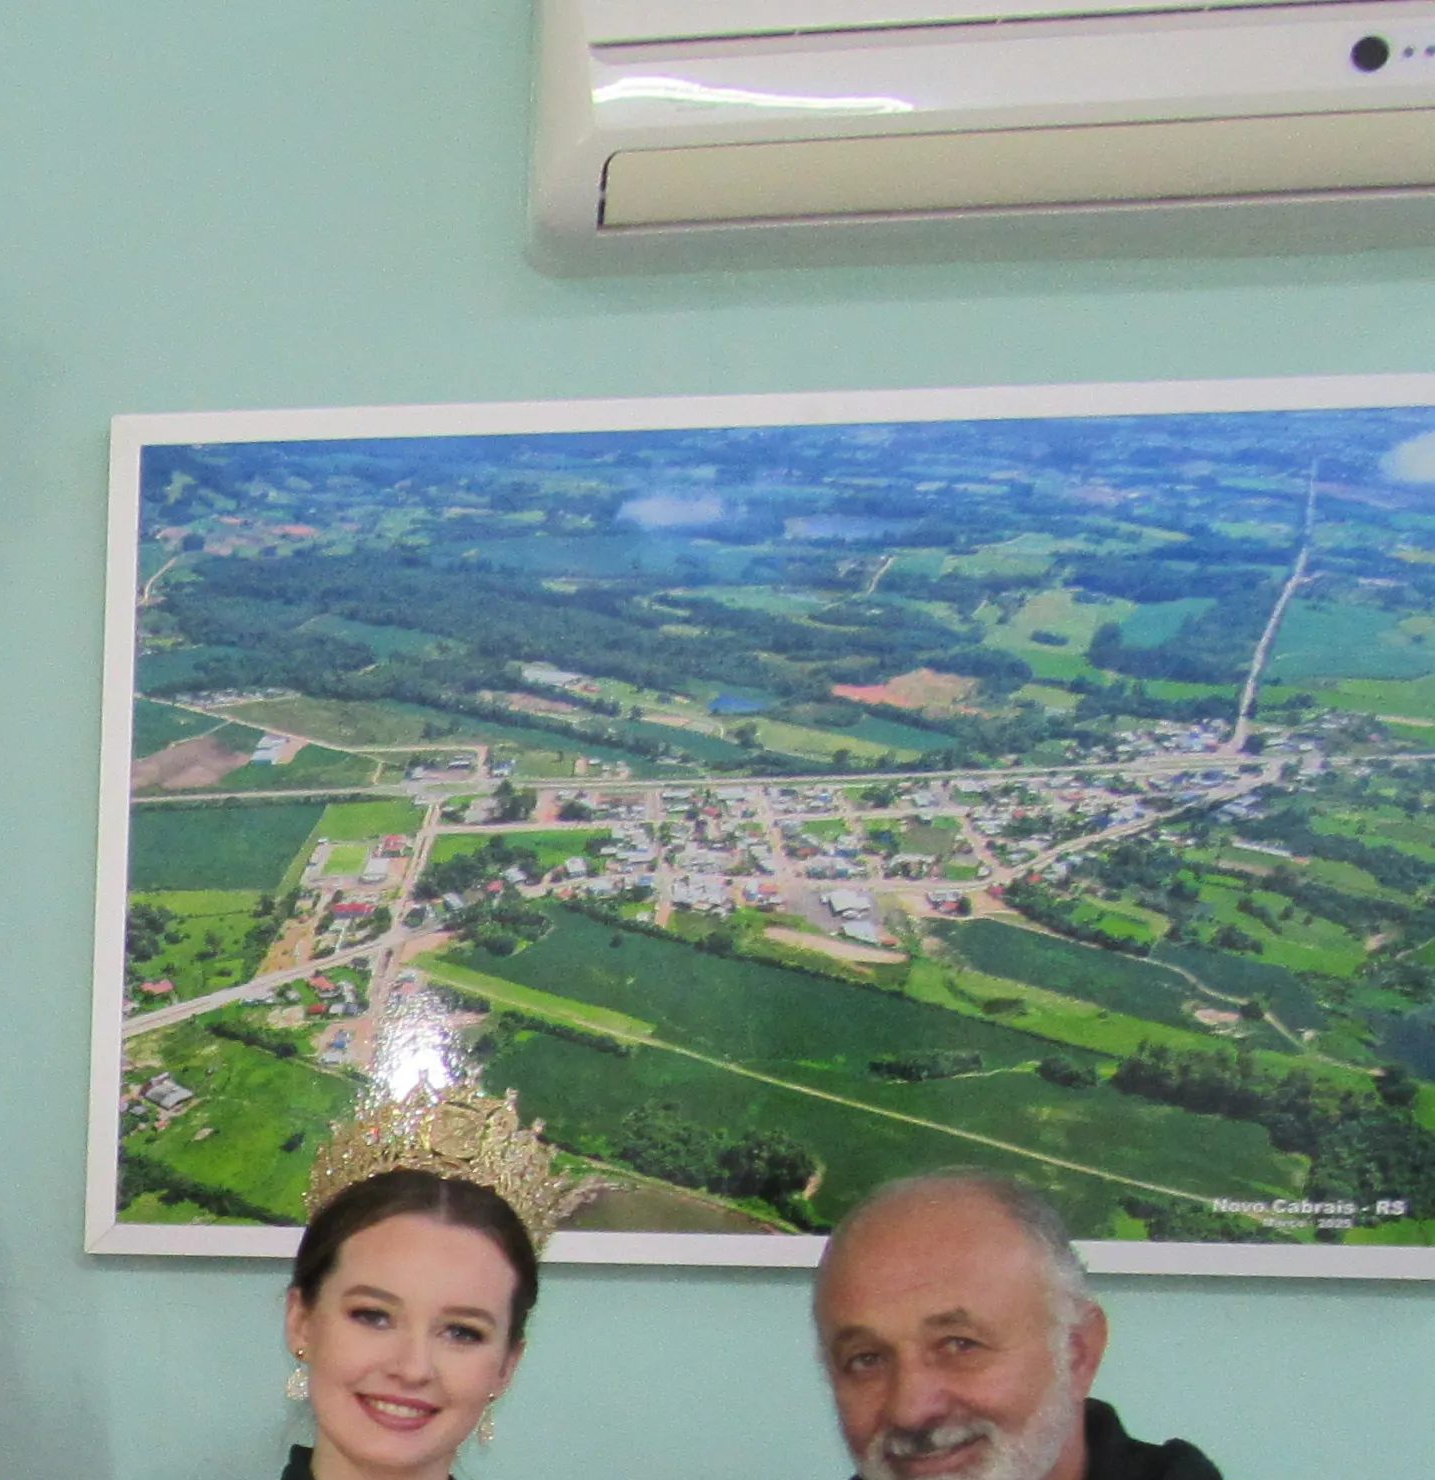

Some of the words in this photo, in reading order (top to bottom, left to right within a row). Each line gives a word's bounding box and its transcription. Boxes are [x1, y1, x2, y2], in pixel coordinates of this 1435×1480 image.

[1213, 1199, 1265, 1213] Novo
[1273, 1199, 1357, 1215] Cabrais
[1375, 1200, 1406, 1215] RS
